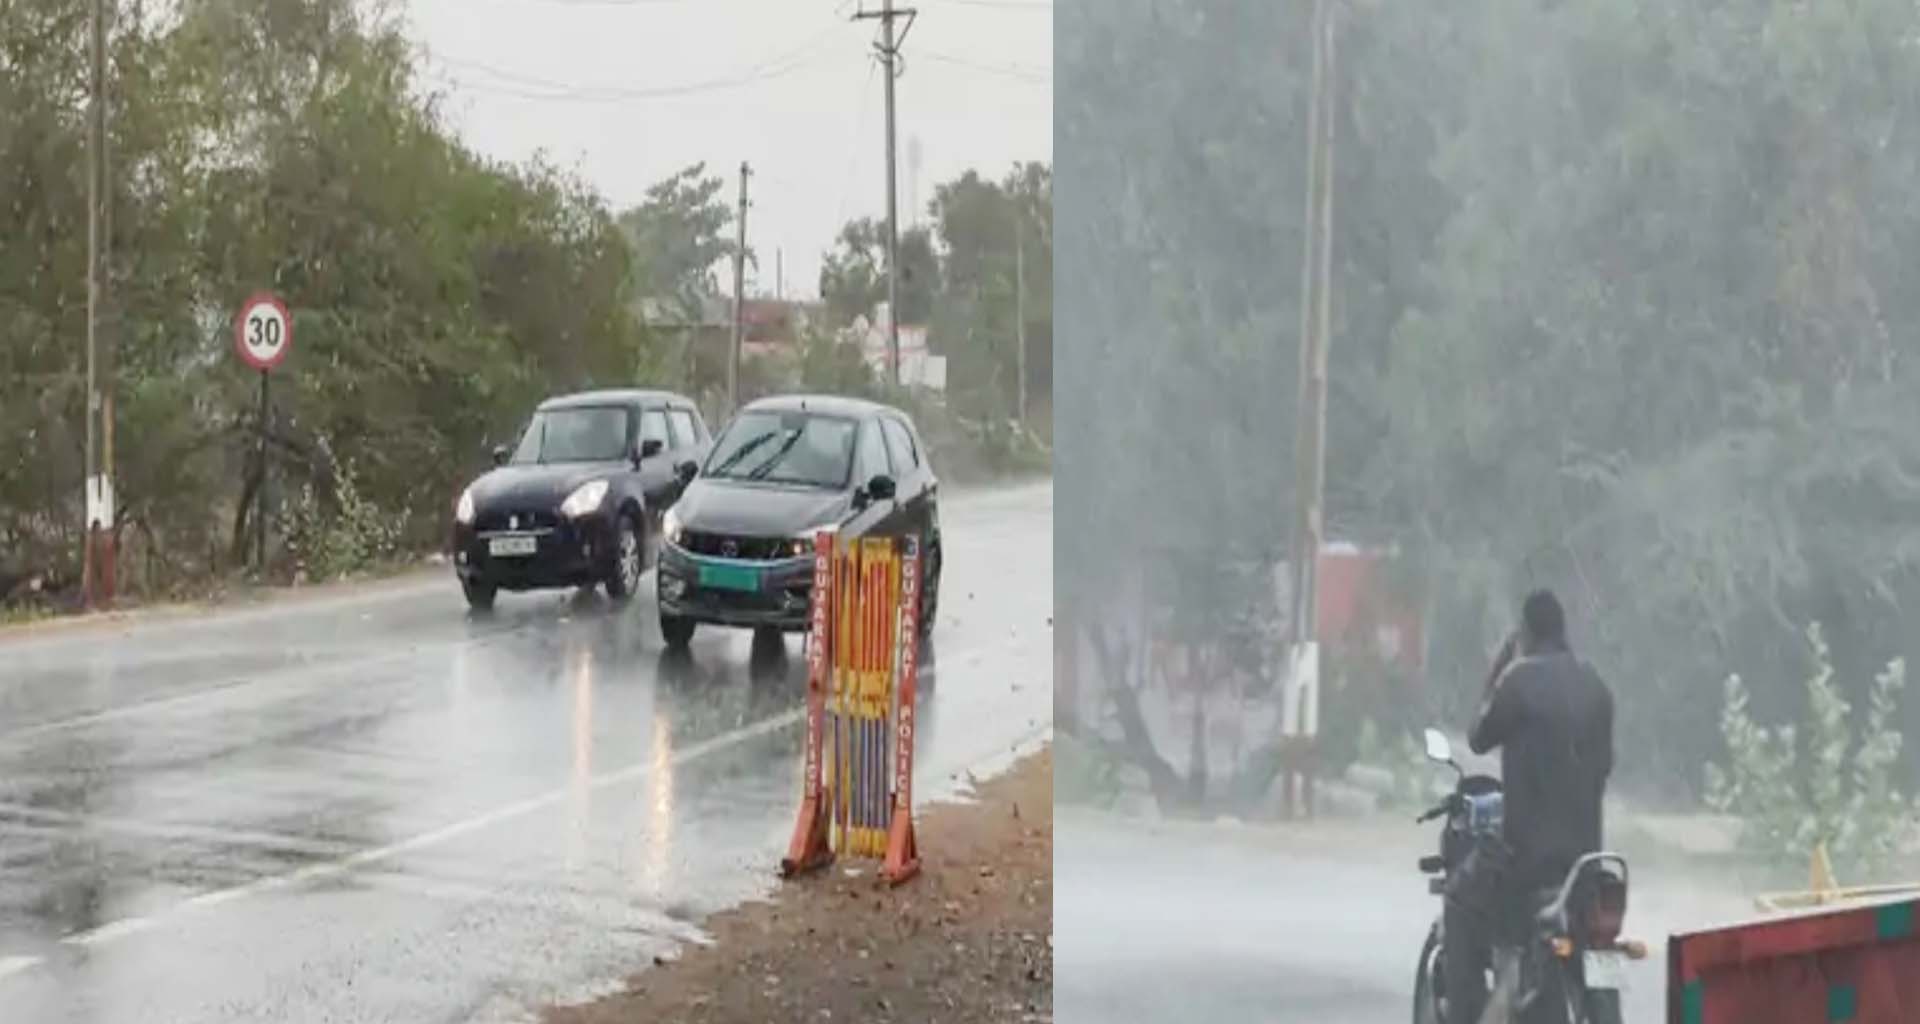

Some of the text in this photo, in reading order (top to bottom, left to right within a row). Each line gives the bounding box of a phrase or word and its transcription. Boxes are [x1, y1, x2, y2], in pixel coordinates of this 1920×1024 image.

[248, 315, 280, 347] 30
[812, 556, 828, 668] GUJARAT
[897, 563, 915, 807] GUJARAT POLICE
